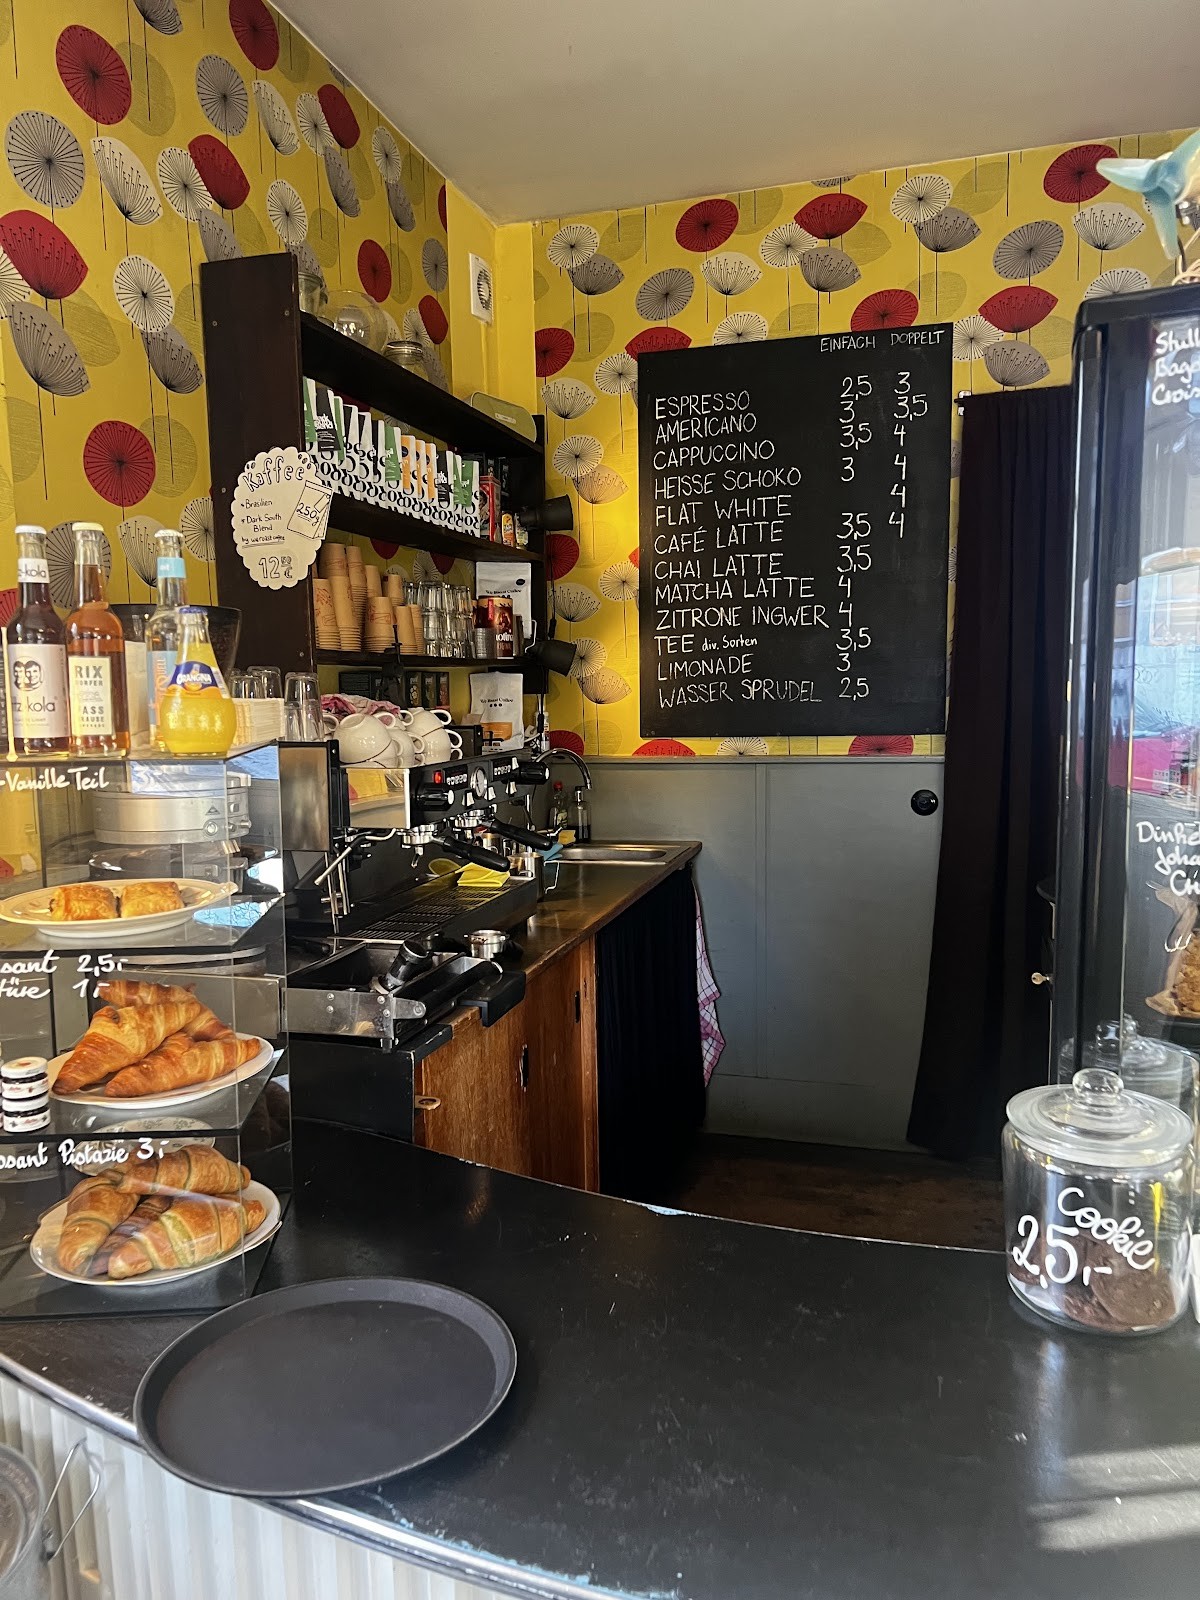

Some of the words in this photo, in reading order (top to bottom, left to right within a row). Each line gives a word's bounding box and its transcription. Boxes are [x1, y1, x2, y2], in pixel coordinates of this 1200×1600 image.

[820, 335, 876, 352] EINFACH
[890, 331, 945, 346] DOPPELT
[655, 390, 750, 420] ESPRESSO
[840, 374, 872, 400] 2,5
[894, 371, 910, 394] 3
[655, 413, 756, 445] AMERICANO
[839, 400, 855, 423] 3
[893, 394, 928, 421] 3,5
[653, 440, 775, 470] CAPPUCCINO
[840, 422, 872, 450] 3,5
[893, 423, 906, 446] 4
[242, 456, 305, 492] Kaffee
[654, 472, 716, 500] HEISSE
[722, 467, 801, 491] SCHOKO
[841, 457, 854, 481] 3
[893, 454, 906, 480] 4
[245, 498, 273, 509] Brasilien
[296, 502, 320, 526] 250g
[655, 501, 703, 527] FLAT
[715, 494, 792, 519] WHITE
[890, 484, 906, 508] 4
[246, 515, 263, 524] Dark
[264, 513, 282, 522] South
[253, 524, 273, 532] Blend
[654, 526, 707, 554] CAFÉ
[716, 521, 784, 548] LATTE
[836, 513, 871, 540] 3,5
[888, 512, 904, 538] 4
[258, 555, 281, 579] 12
[654, 558, 701, 580] CHAI
[712, 553, 783, 577] LATTE
[837, 545, 872, 573] 3,5
[655, 579, 733, 605] MATCHA
[743, 577, 815, 598] LATTE
[838, 575, 851, 598] 4
[657, 606, 742, 630] ZITRONE
[752, 605, 830, 628] INGWER
[838, 601, 852, 627] 4
[654, 635, 694, 655] TEE
[702, 639, 719, 651] div.
[722, 636, 758, 648] Sorten
[836, 628, 871, 651] 3,5
[75, 665, 103, 679] RIX
[657, 654, 754, 681] LIMONADE
[836, 653, 851, 672] 3
[658, 682, 733, 709] WASSER
[741, 678, 822, 703] SPRUDEL
[838, 677, 870, 701] 2,5
[67, 766, 110, 791] Teil
[57, 1138, 130, 1166] Pistazie
[1057, 1186, 1156, 1270] Cookie
